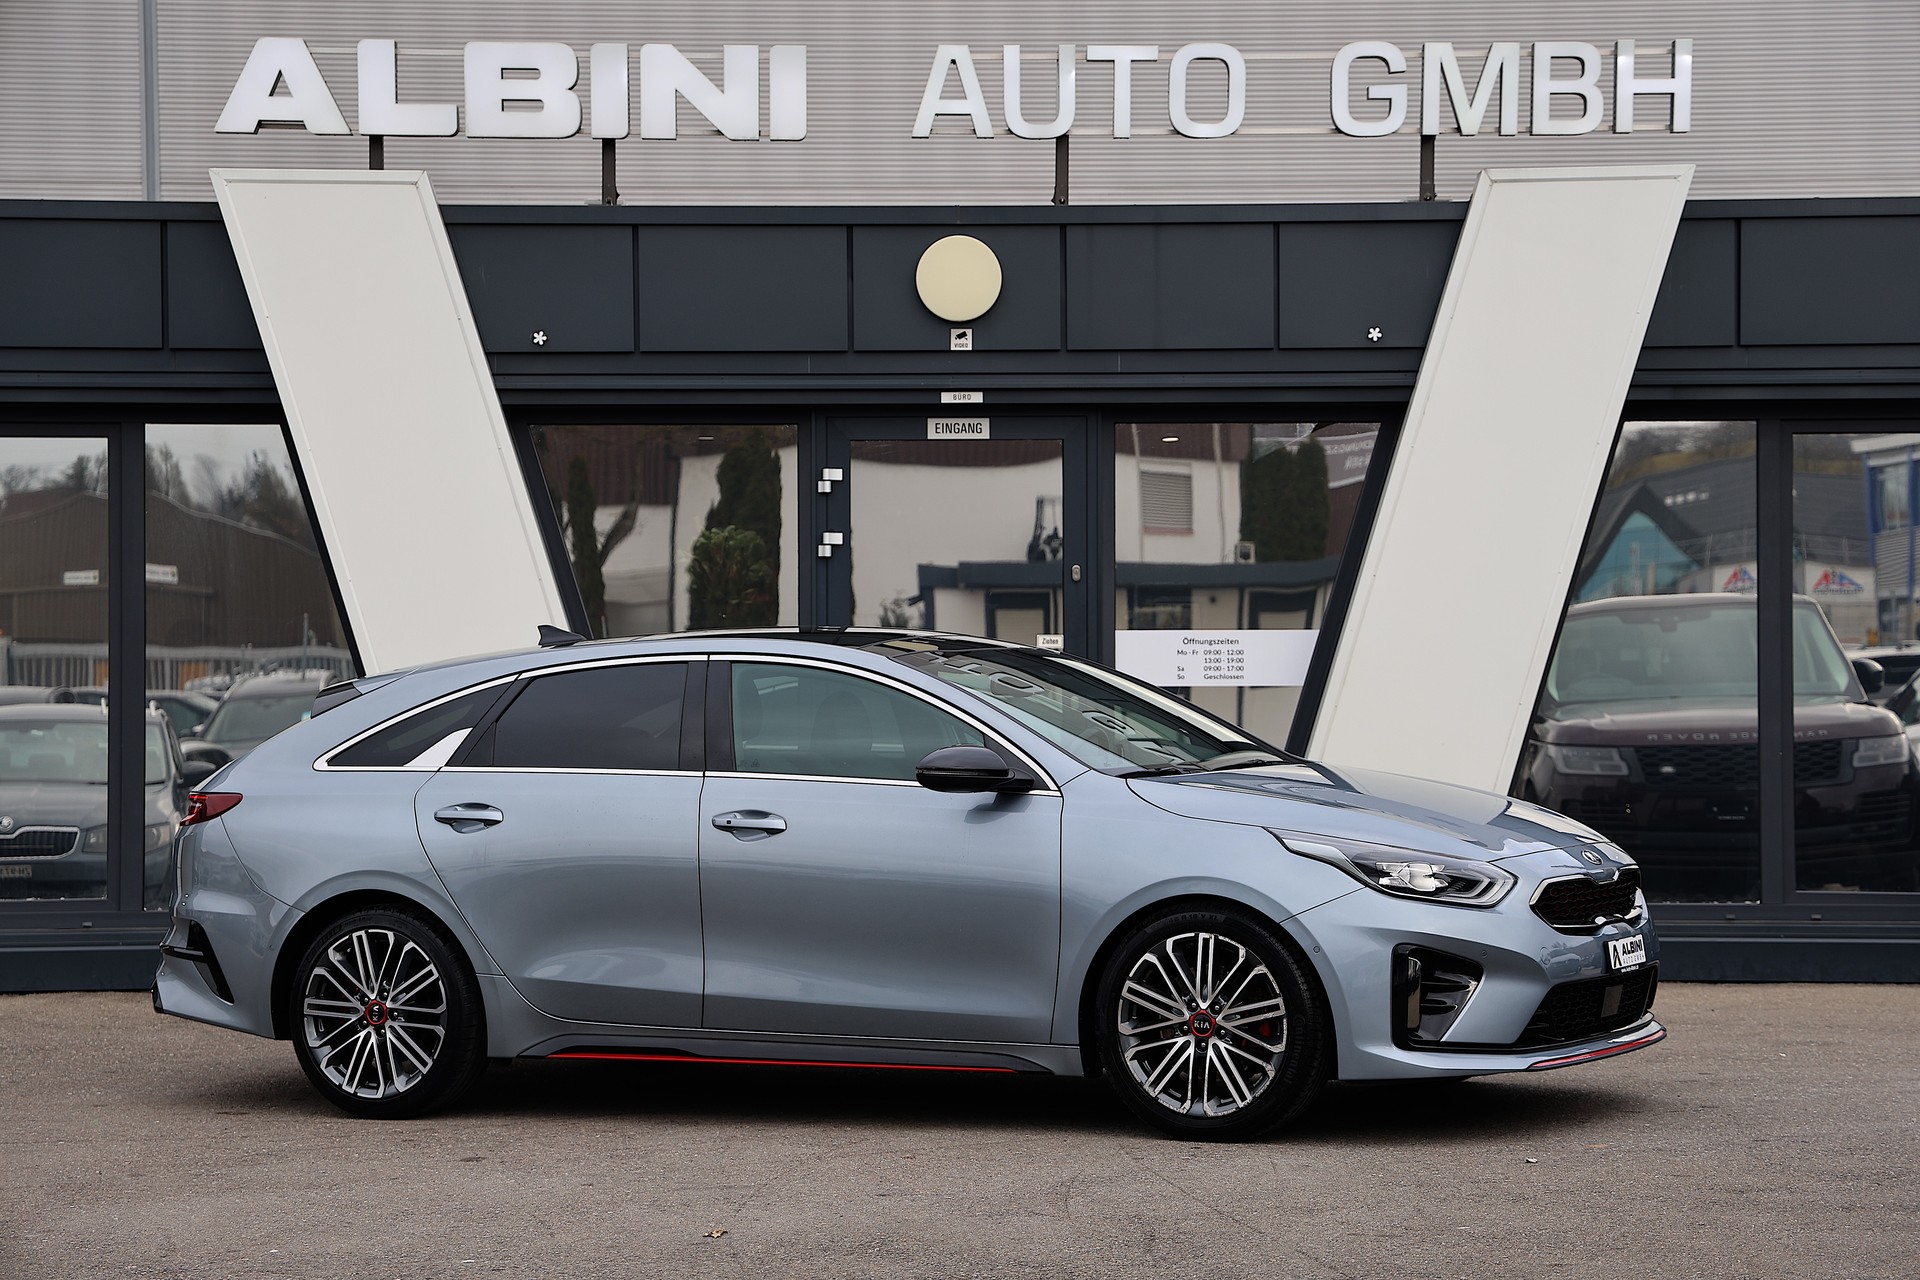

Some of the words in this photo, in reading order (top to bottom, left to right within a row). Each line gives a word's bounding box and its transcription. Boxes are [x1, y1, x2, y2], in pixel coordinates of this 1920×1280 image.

[214, 36, 808, 141] ALBINI
[911, 42, 1247, 140] AUTO
[1329, 37, 1694, 138] GMBH
[952, 392, 972, 401] BÜRO
[934, 422, 983, 434] EINGANG
[1042, 637, 1059, 645] Ziehen
[1182, 637, 1240, 646] Öffnungszeiten
[1622, 939, 1643, 956] ALBINI
[372, 1005, 380, 1021] KIA
[1193, 1020, 1210, 1029] KIA
